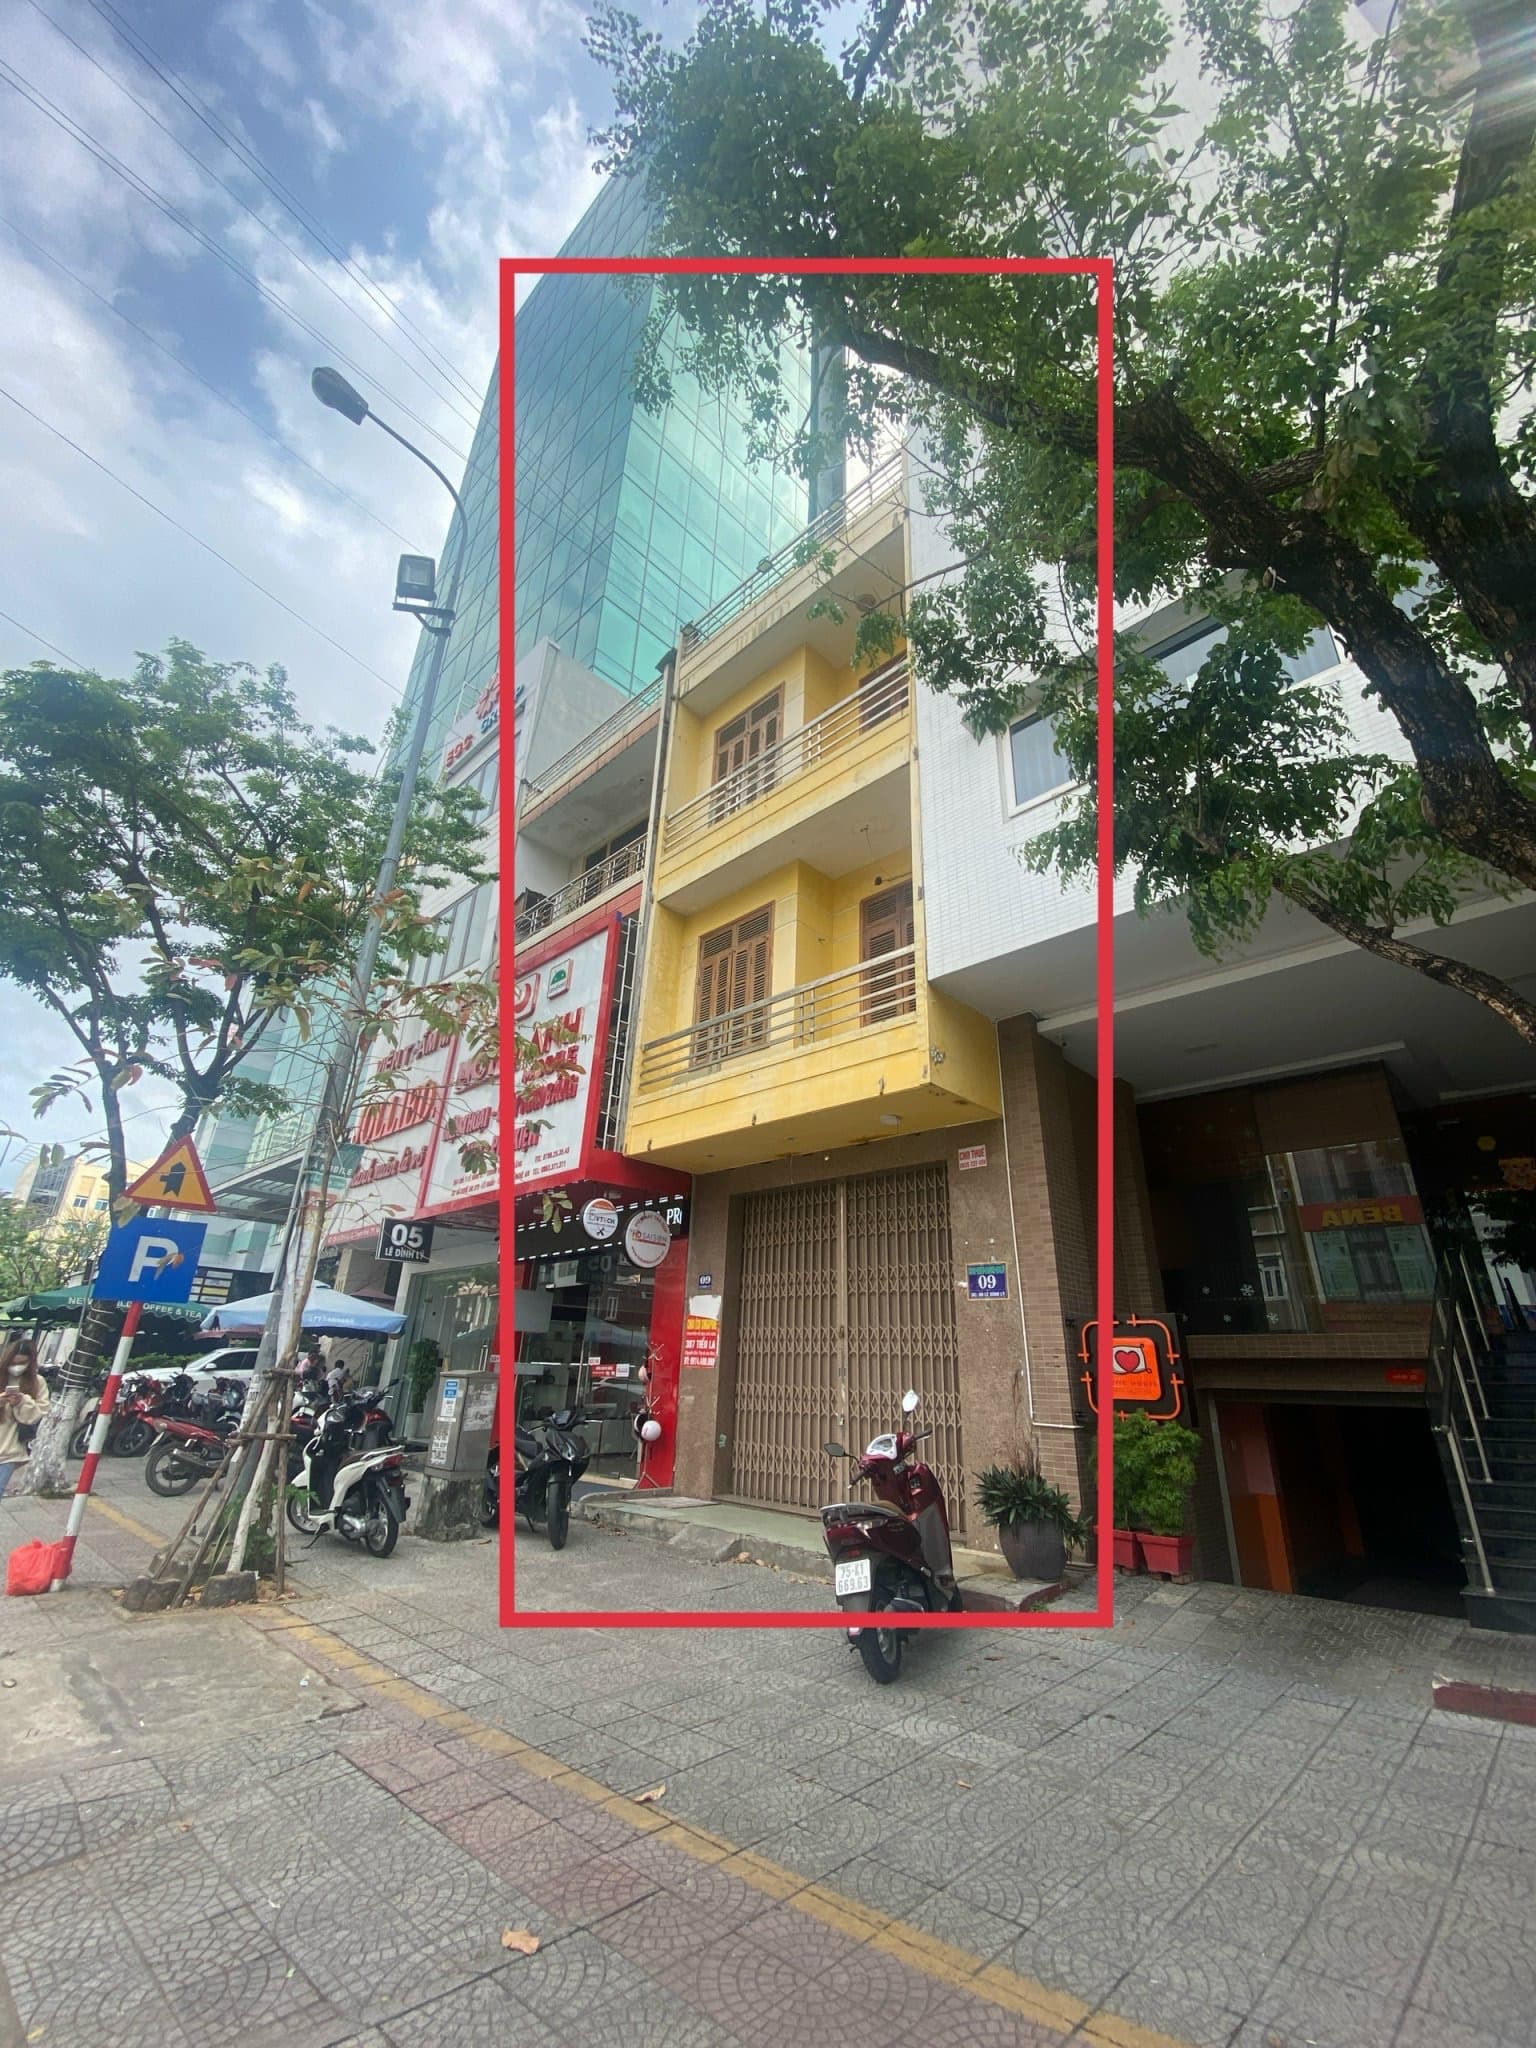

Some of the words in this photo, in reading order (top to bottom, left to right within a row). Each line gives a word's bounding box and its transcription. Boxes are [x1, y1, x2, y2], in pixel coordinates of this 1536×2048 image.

[391, 1223, 424, 1248] 05
[128, 1235, 181, 1283] P
[700, 1275, 711, 1285] 09
[978, 1274, 997, 1289] 09
[185, 1309, 202, 1319] TEA
